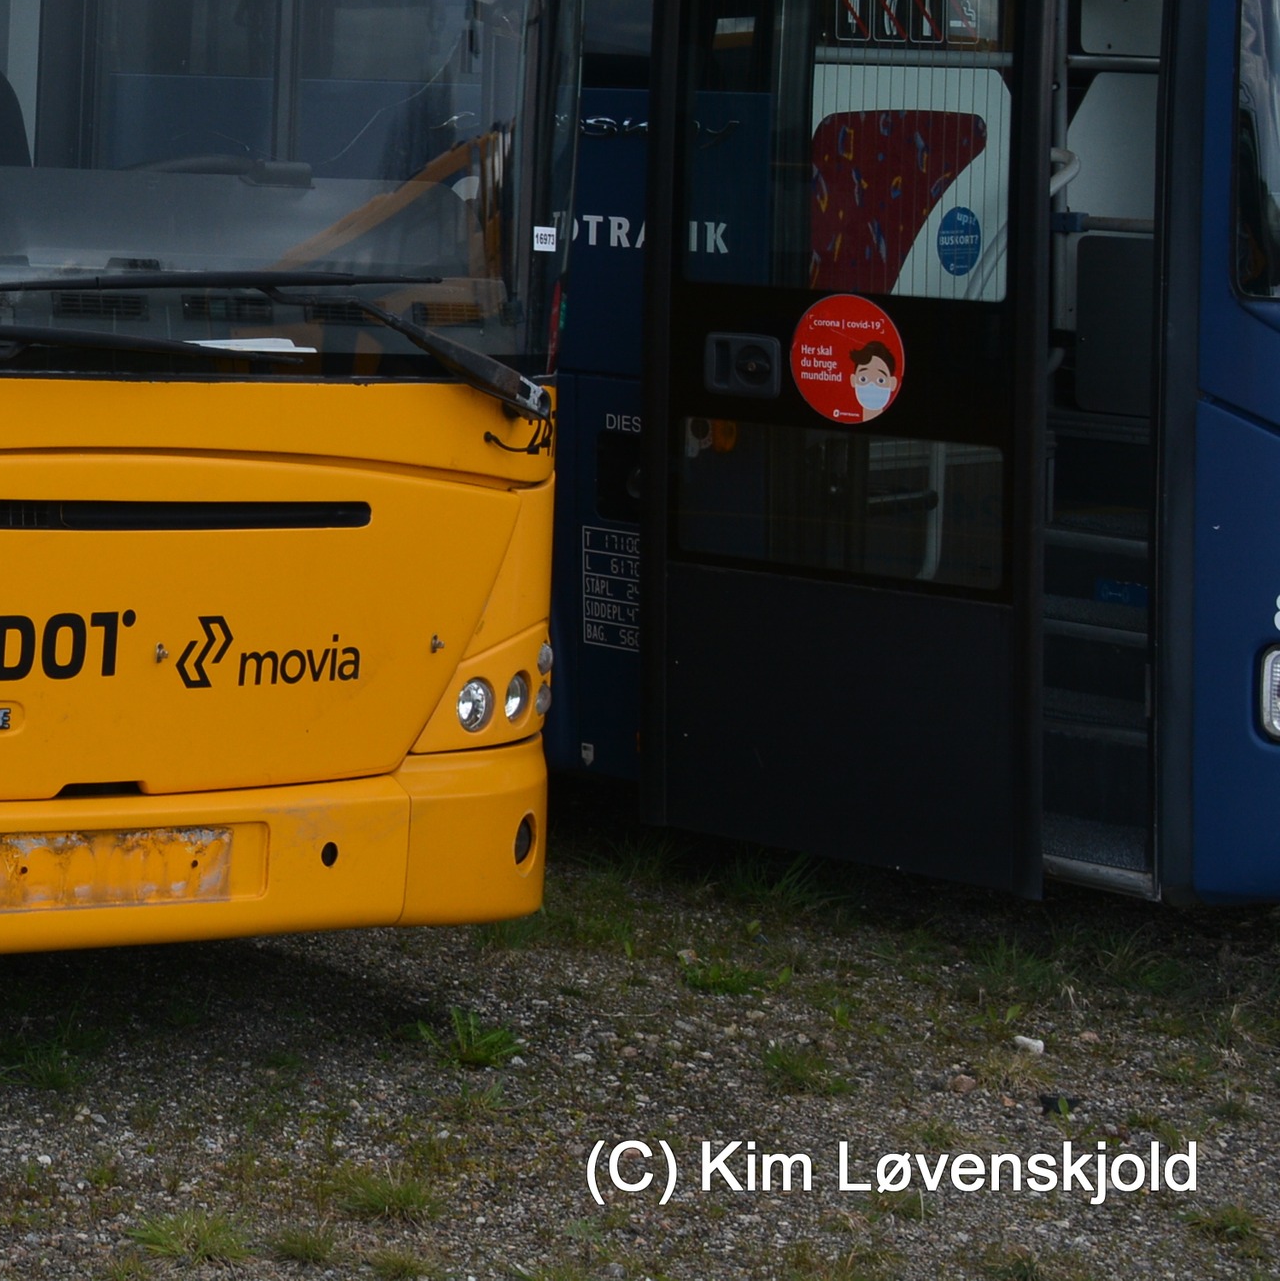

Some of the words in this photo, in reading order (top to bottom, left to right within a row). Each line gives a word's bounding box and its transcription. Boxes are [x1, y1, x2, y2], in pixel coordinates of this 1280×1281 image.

[535, 232, 555, 246] 16973
[813, 319, 840, 328] corona
[846, 320, 881, 330] covid-19
[801, 344, 815, 355] Her
[817, 345, 832, 356] skal
[801, 358, 812, 367] du
[813, 358, 837, 371] bruge
[800, 371, 842, 382] mundbind
[585, 531, 591, 547] T
[585, 554, 591, 571] L
[585, 599, 625, 623] SIDDEPL.
[586, 622, 608, 642] BAG.
[237, 633, 361, 687] movia
